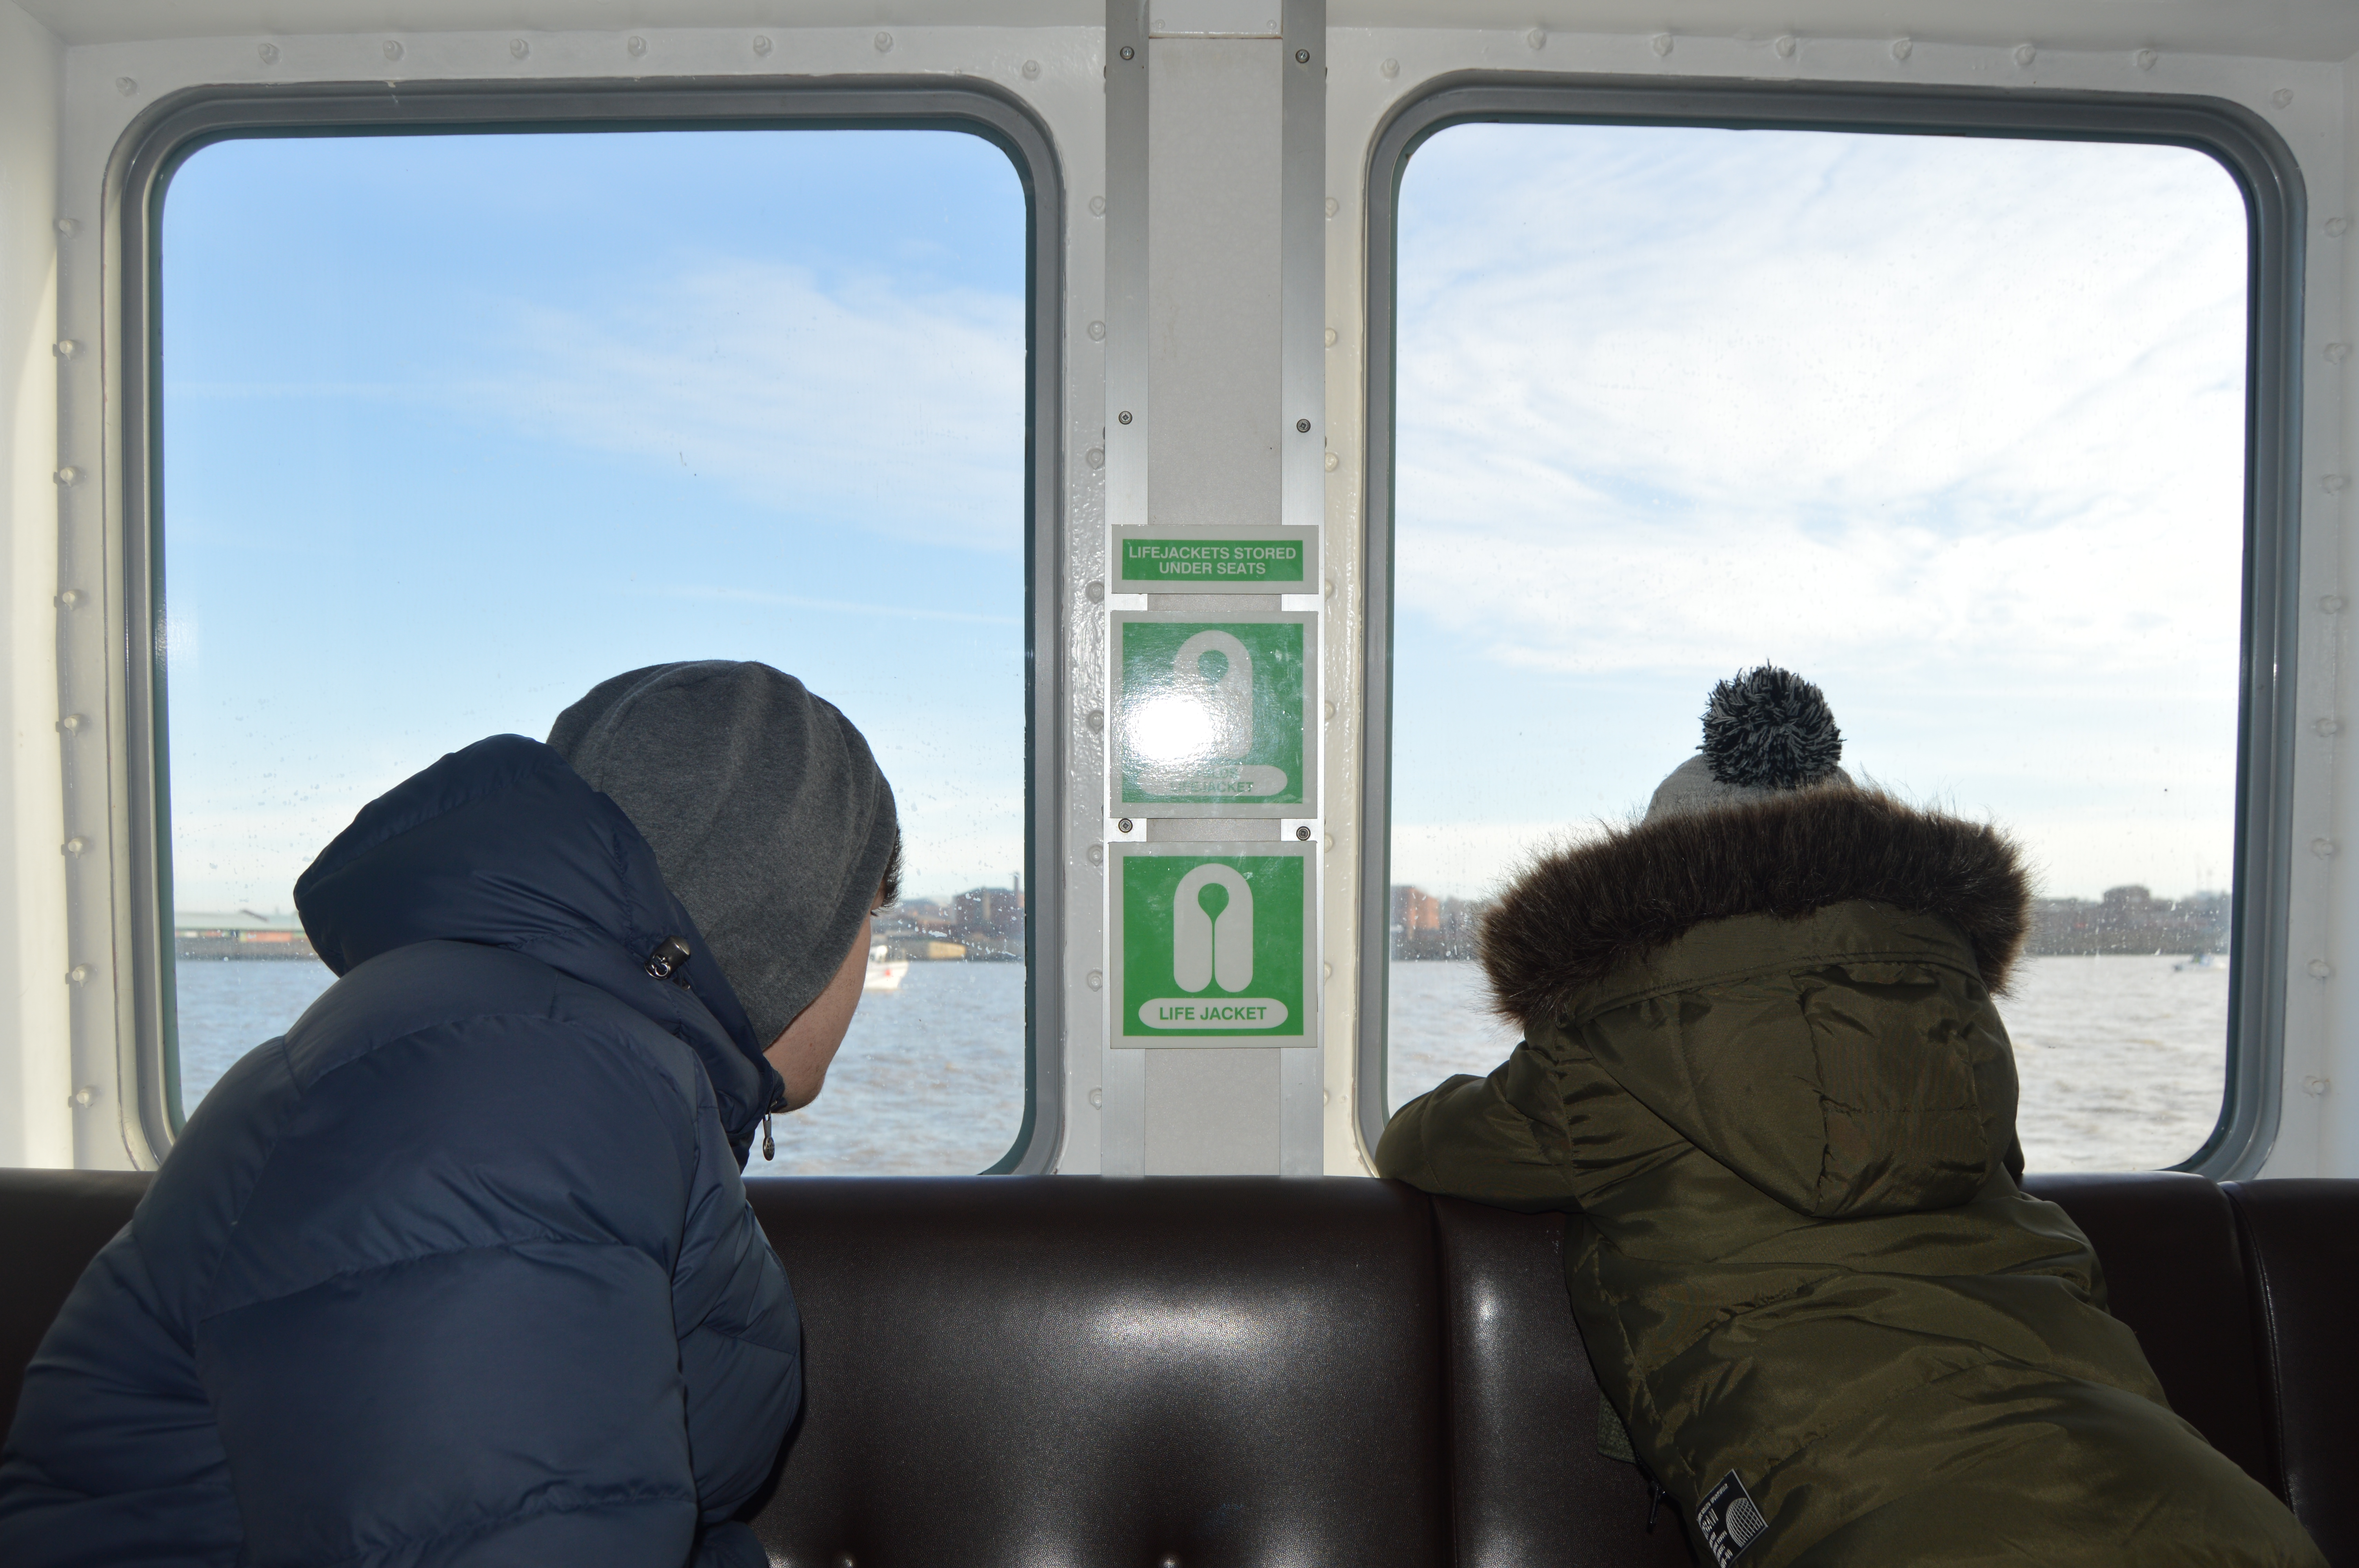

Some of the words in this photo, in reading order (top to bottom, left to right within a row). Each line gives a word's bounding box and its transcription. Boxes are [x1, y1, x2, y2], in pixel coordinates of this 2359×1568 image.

[1129, 546, 1229, 559] LIFEJACKETS
[1234, 547, 1296, 559] STORED
[1159, 562, 1212, 574] UNDER
[1217, 562, 1266, 574] SEATS
[1170, 782, 1254, 792] LIFEJACKET
[1160, 1007, 1195, 1020] LIFE
[1200, 1007, 1267, 1020] JACKET
